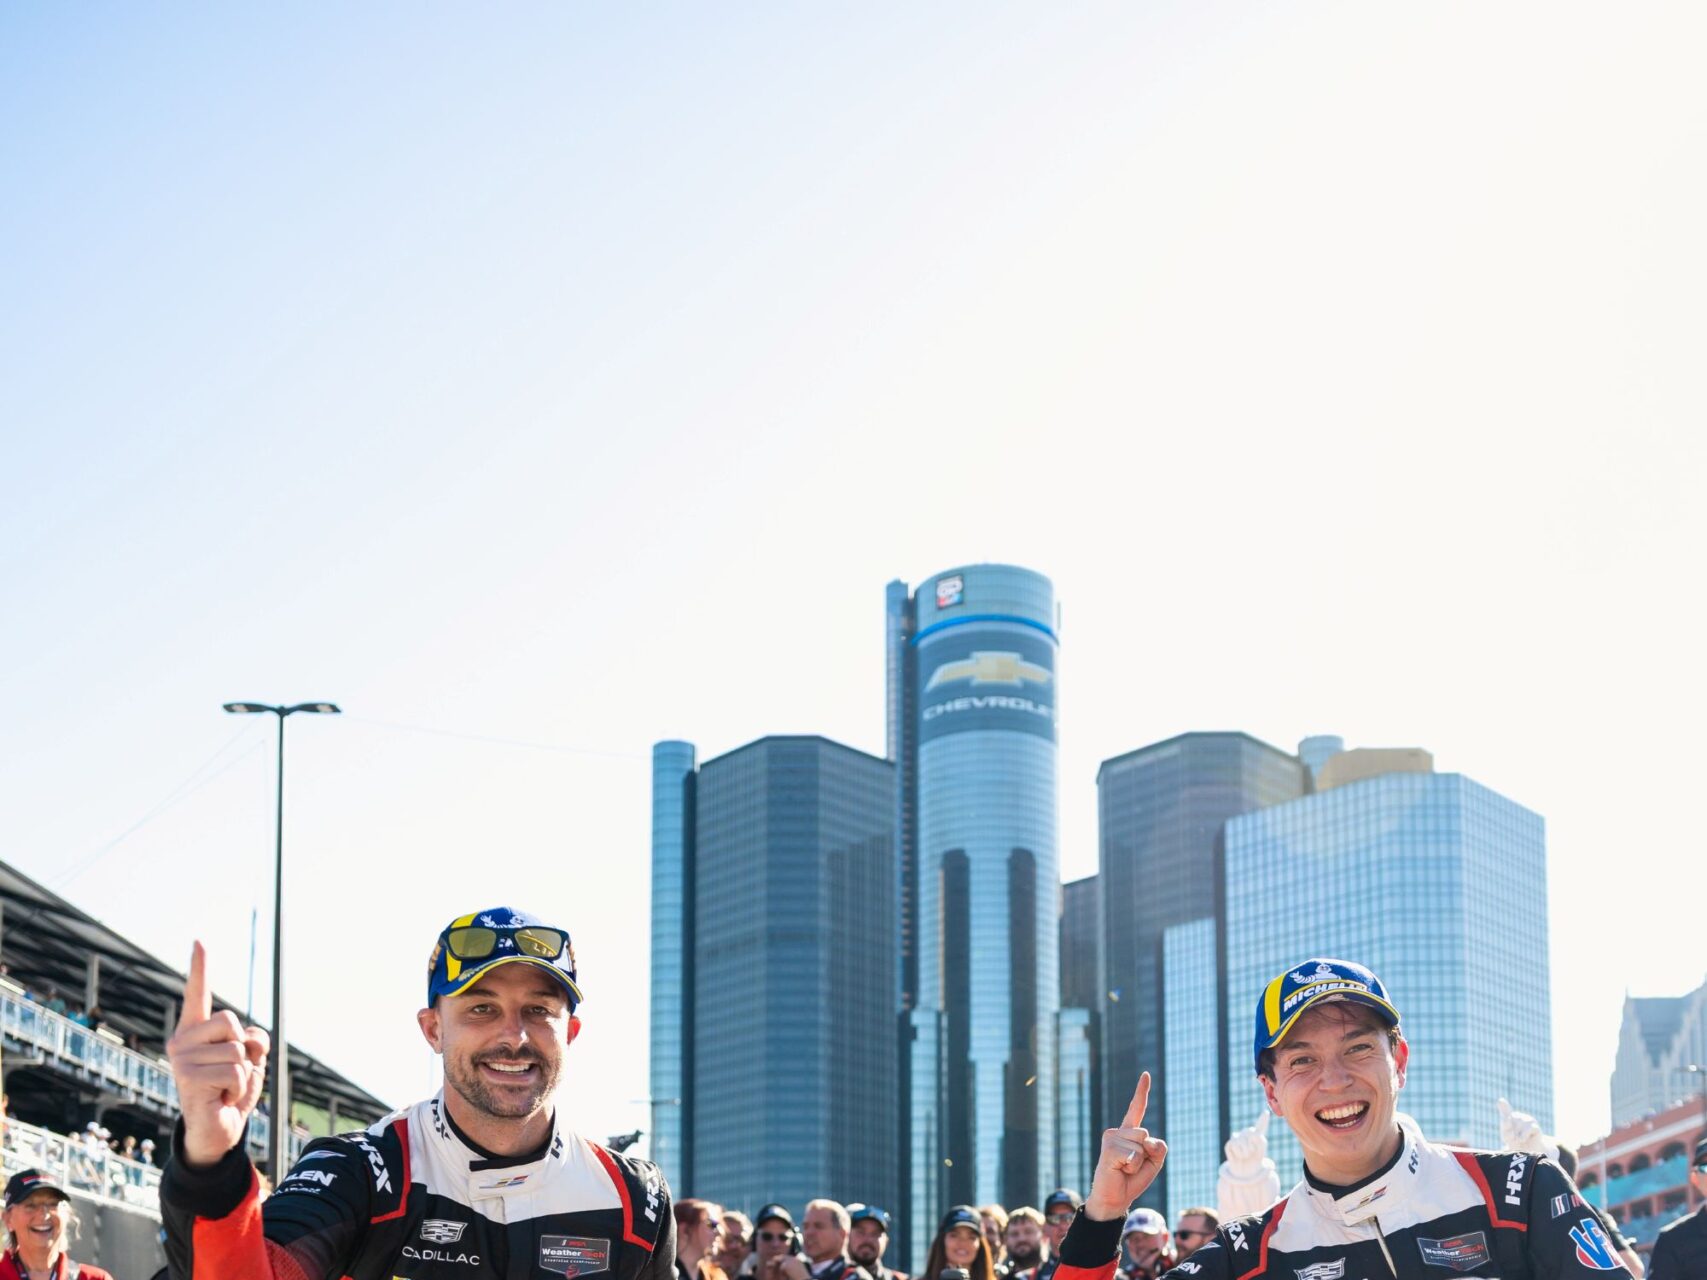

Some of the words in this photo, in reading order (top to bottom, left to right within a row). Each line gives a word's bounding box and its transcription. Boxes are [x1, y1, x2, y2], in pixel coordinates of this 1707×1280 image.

[922, 695, 1056, 720] CHEVROLE
[1505, 1153, 1527, 1206] HRX
[401, 1246, 481, 1266] CADILLAC
